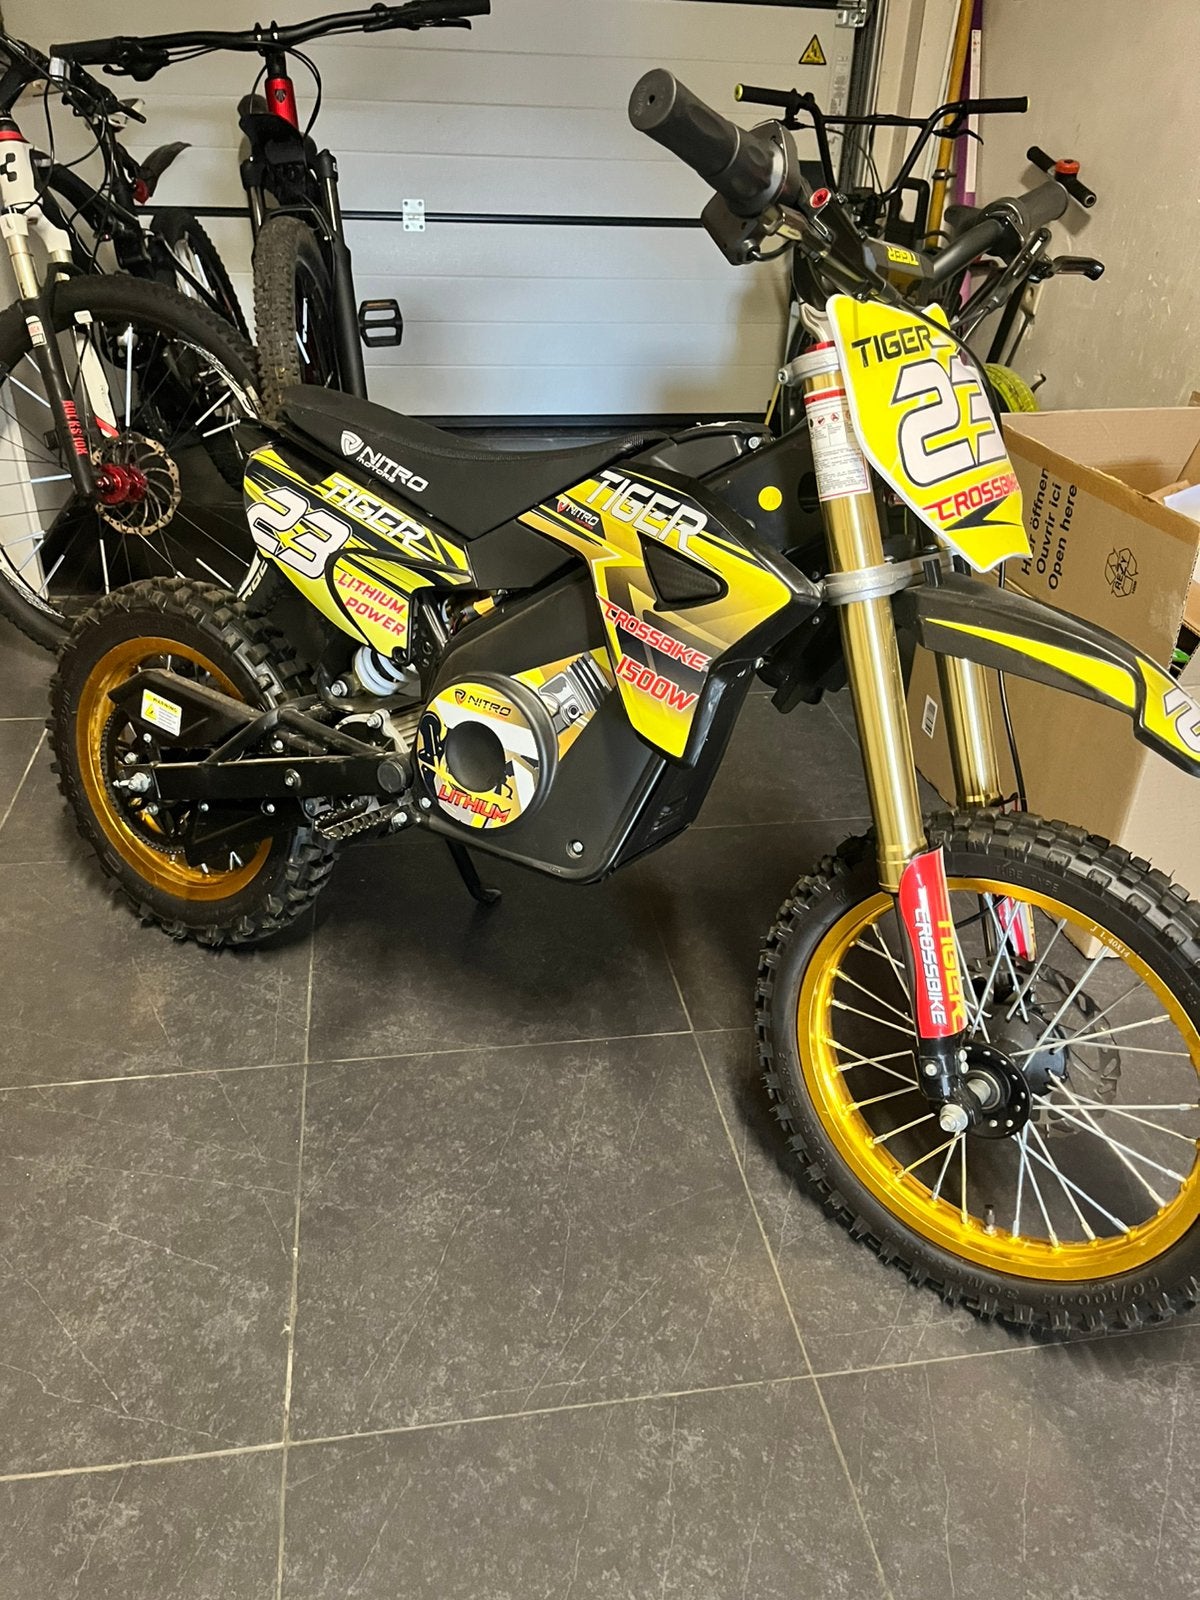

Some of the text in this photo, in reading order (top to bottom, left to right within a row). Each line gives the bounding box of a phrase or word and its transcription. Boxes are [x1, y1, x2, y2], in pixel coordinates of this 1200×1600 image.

[851, 325, 937, 367] TIGER
[359, 445, 429, 493] NITRO
[922, 473, 1021, 521] CROSSB
[246, 486, 353, 580] 23
[322, 476, 430, 555] TIGER
[566, 504, 600, 526] NITRO
[586, 470, 711, 558] TIGER
[1021, 468, 1050, 576] Her öffnen
[1036, 482, 1062, 574] Ouvrir ici
[1048, 484, 1078, 590] Open here
[337, 572, 407, 615] LITHIUM
[345, 596, 407, 636] POWER
[596, 592, 713, 671] CROSSBIKE
[467, 695, 512, 717] NITRO
[615, 654, 700, 713] 1500W
[437, 784, 512, 823] LITHIUM
[914, 884, 948, 1025] CROSSBIKE
